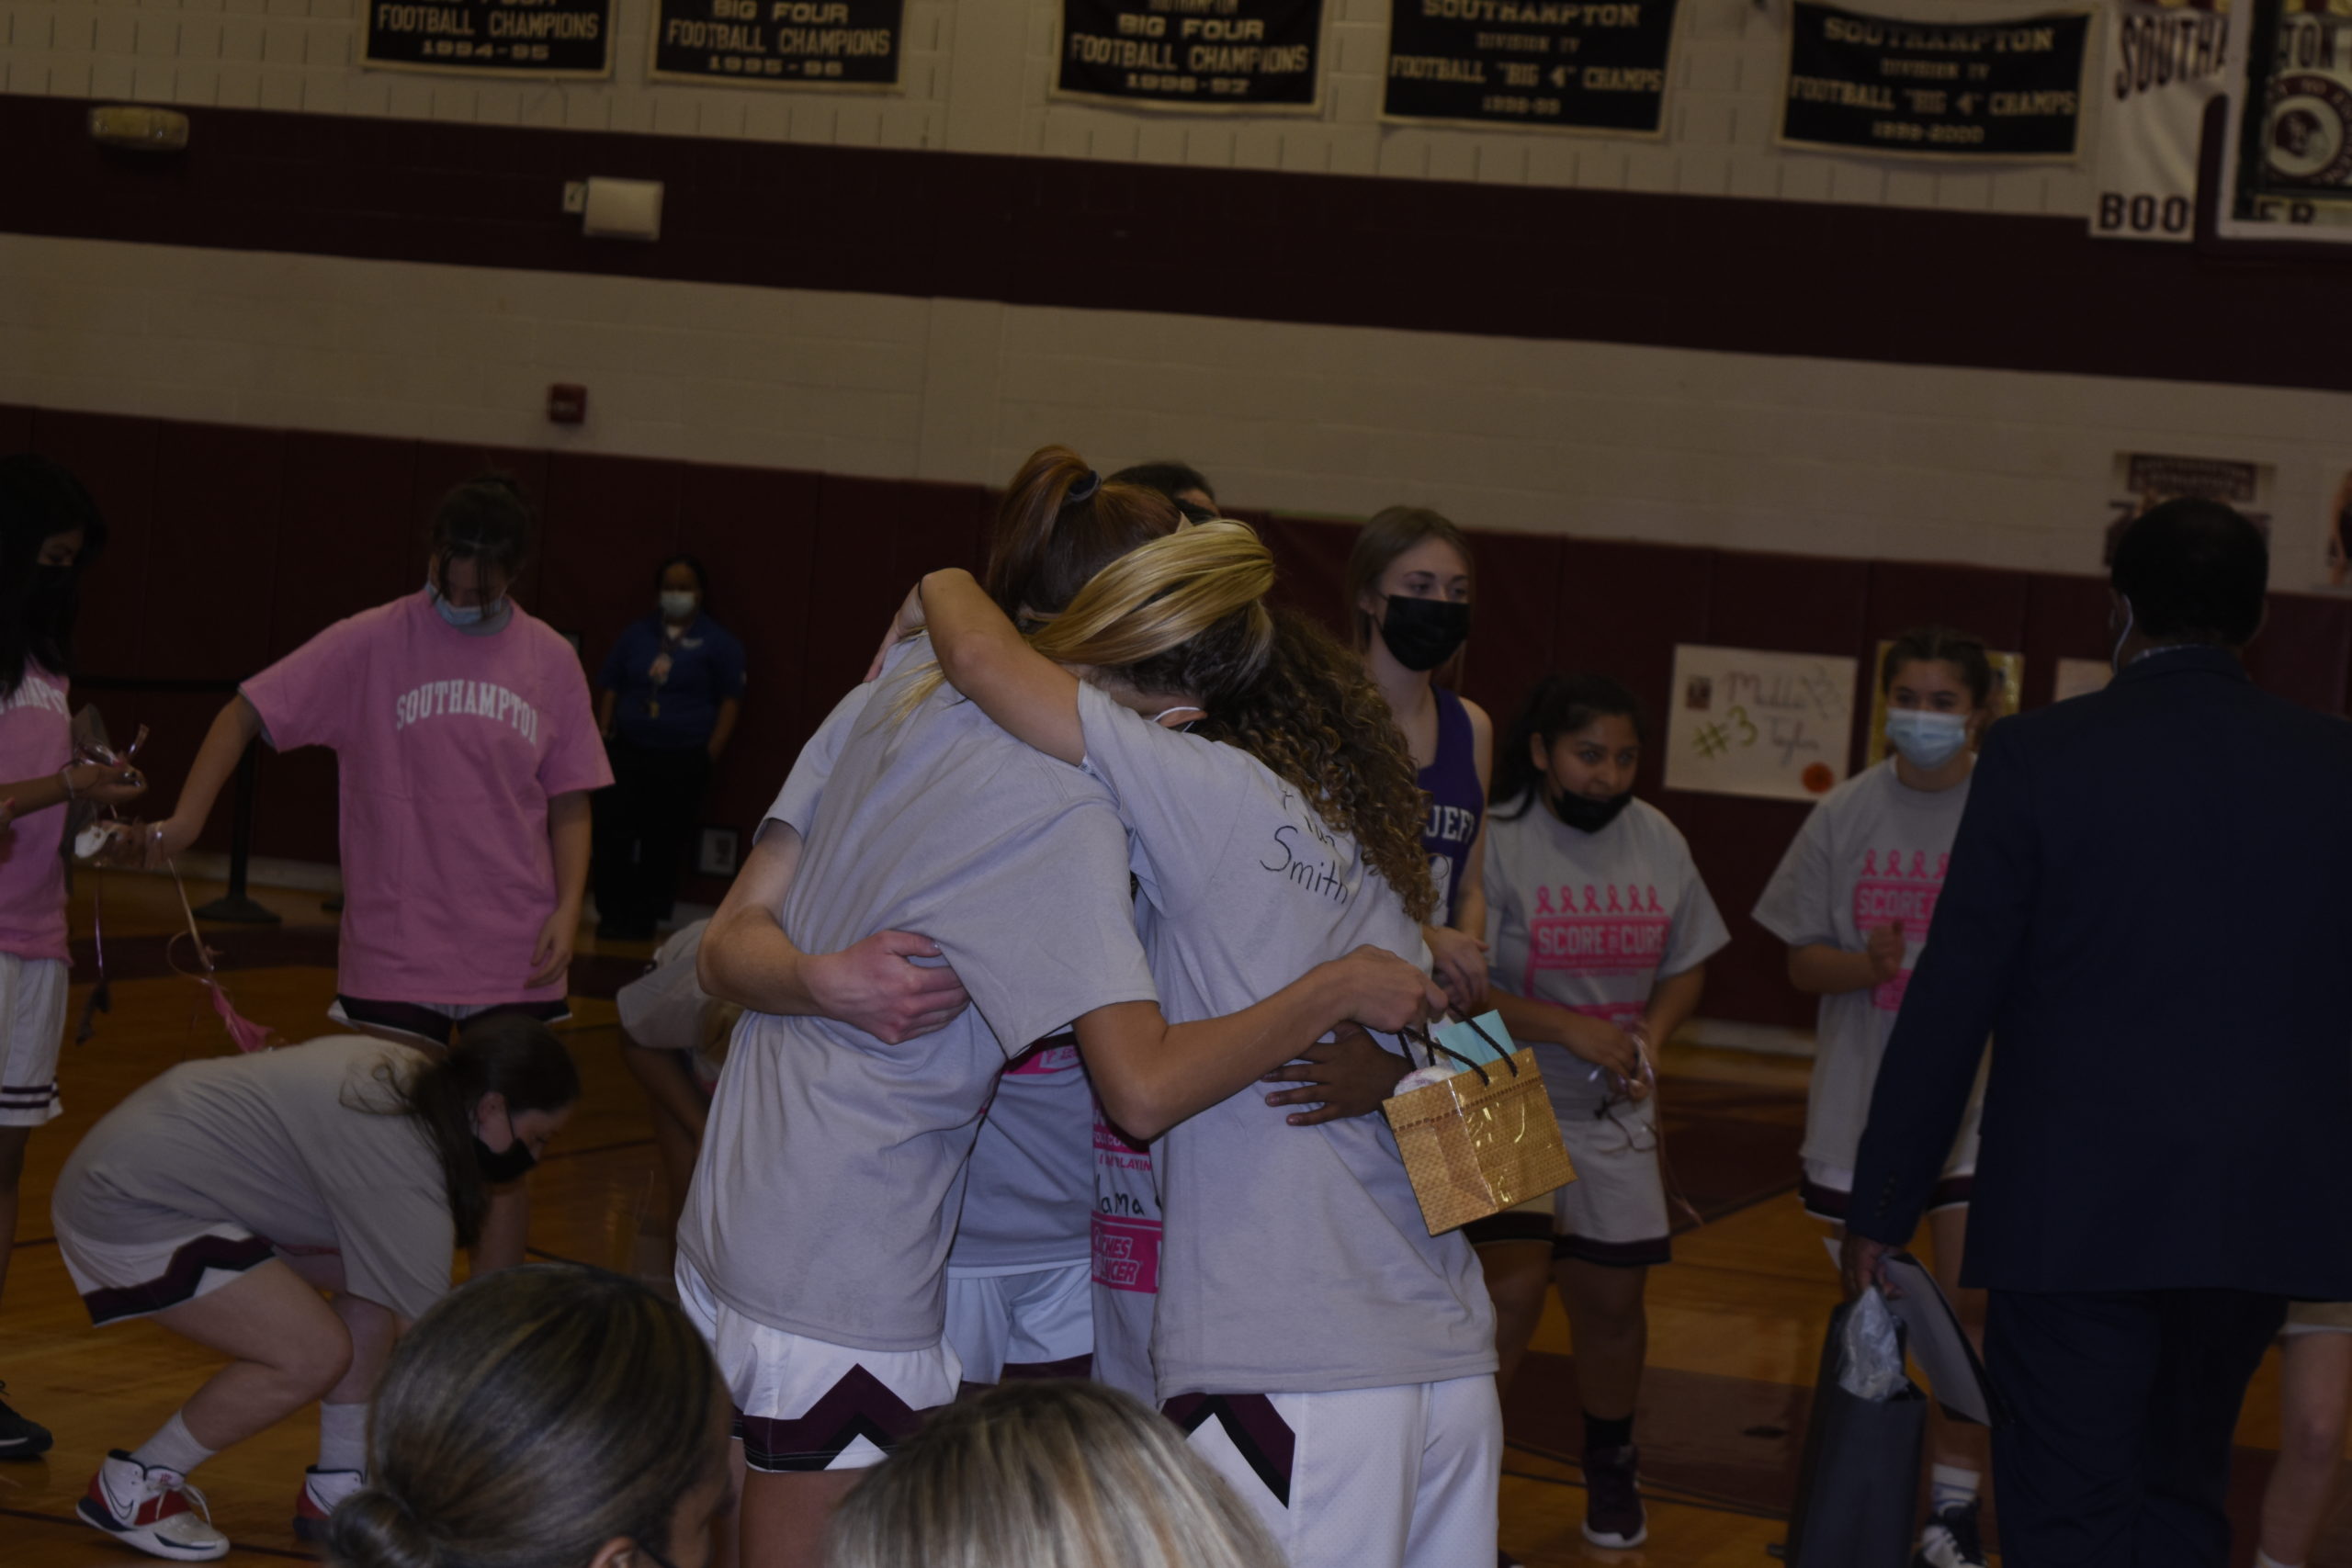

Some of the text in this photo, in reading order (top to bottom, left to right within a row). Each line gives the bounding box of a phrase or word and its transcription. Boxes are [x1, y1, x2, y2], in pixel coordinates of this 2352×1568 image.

[378, 4, 600, 39] FOOTBALL CHAMPIONS
[712, 0, 849, 25] BIG FOUR
[1117, 13, 1265, 41] BIG FOUR
[667, 19, 891, 57] FOOTBALL CHAMPIONS
[1824, 17, 2055, 51] SOUTHAMPTON
[1069, 32, 1309, 73] FOOTBALL CHAMPIONS
[1390, 54, 1487, 84] FOOTBALL
[1582, 66, 1663, 91] CHAMPS
[1792, 75, 1896, 111] FOOTBALL
[1988, 91, 2076, 117] CHAMPS
[2099, 192, 2189, 233] BOO
[1859, 887, 1928, 919] SCORE
[1538, 925, 1606, 956] SCORE
